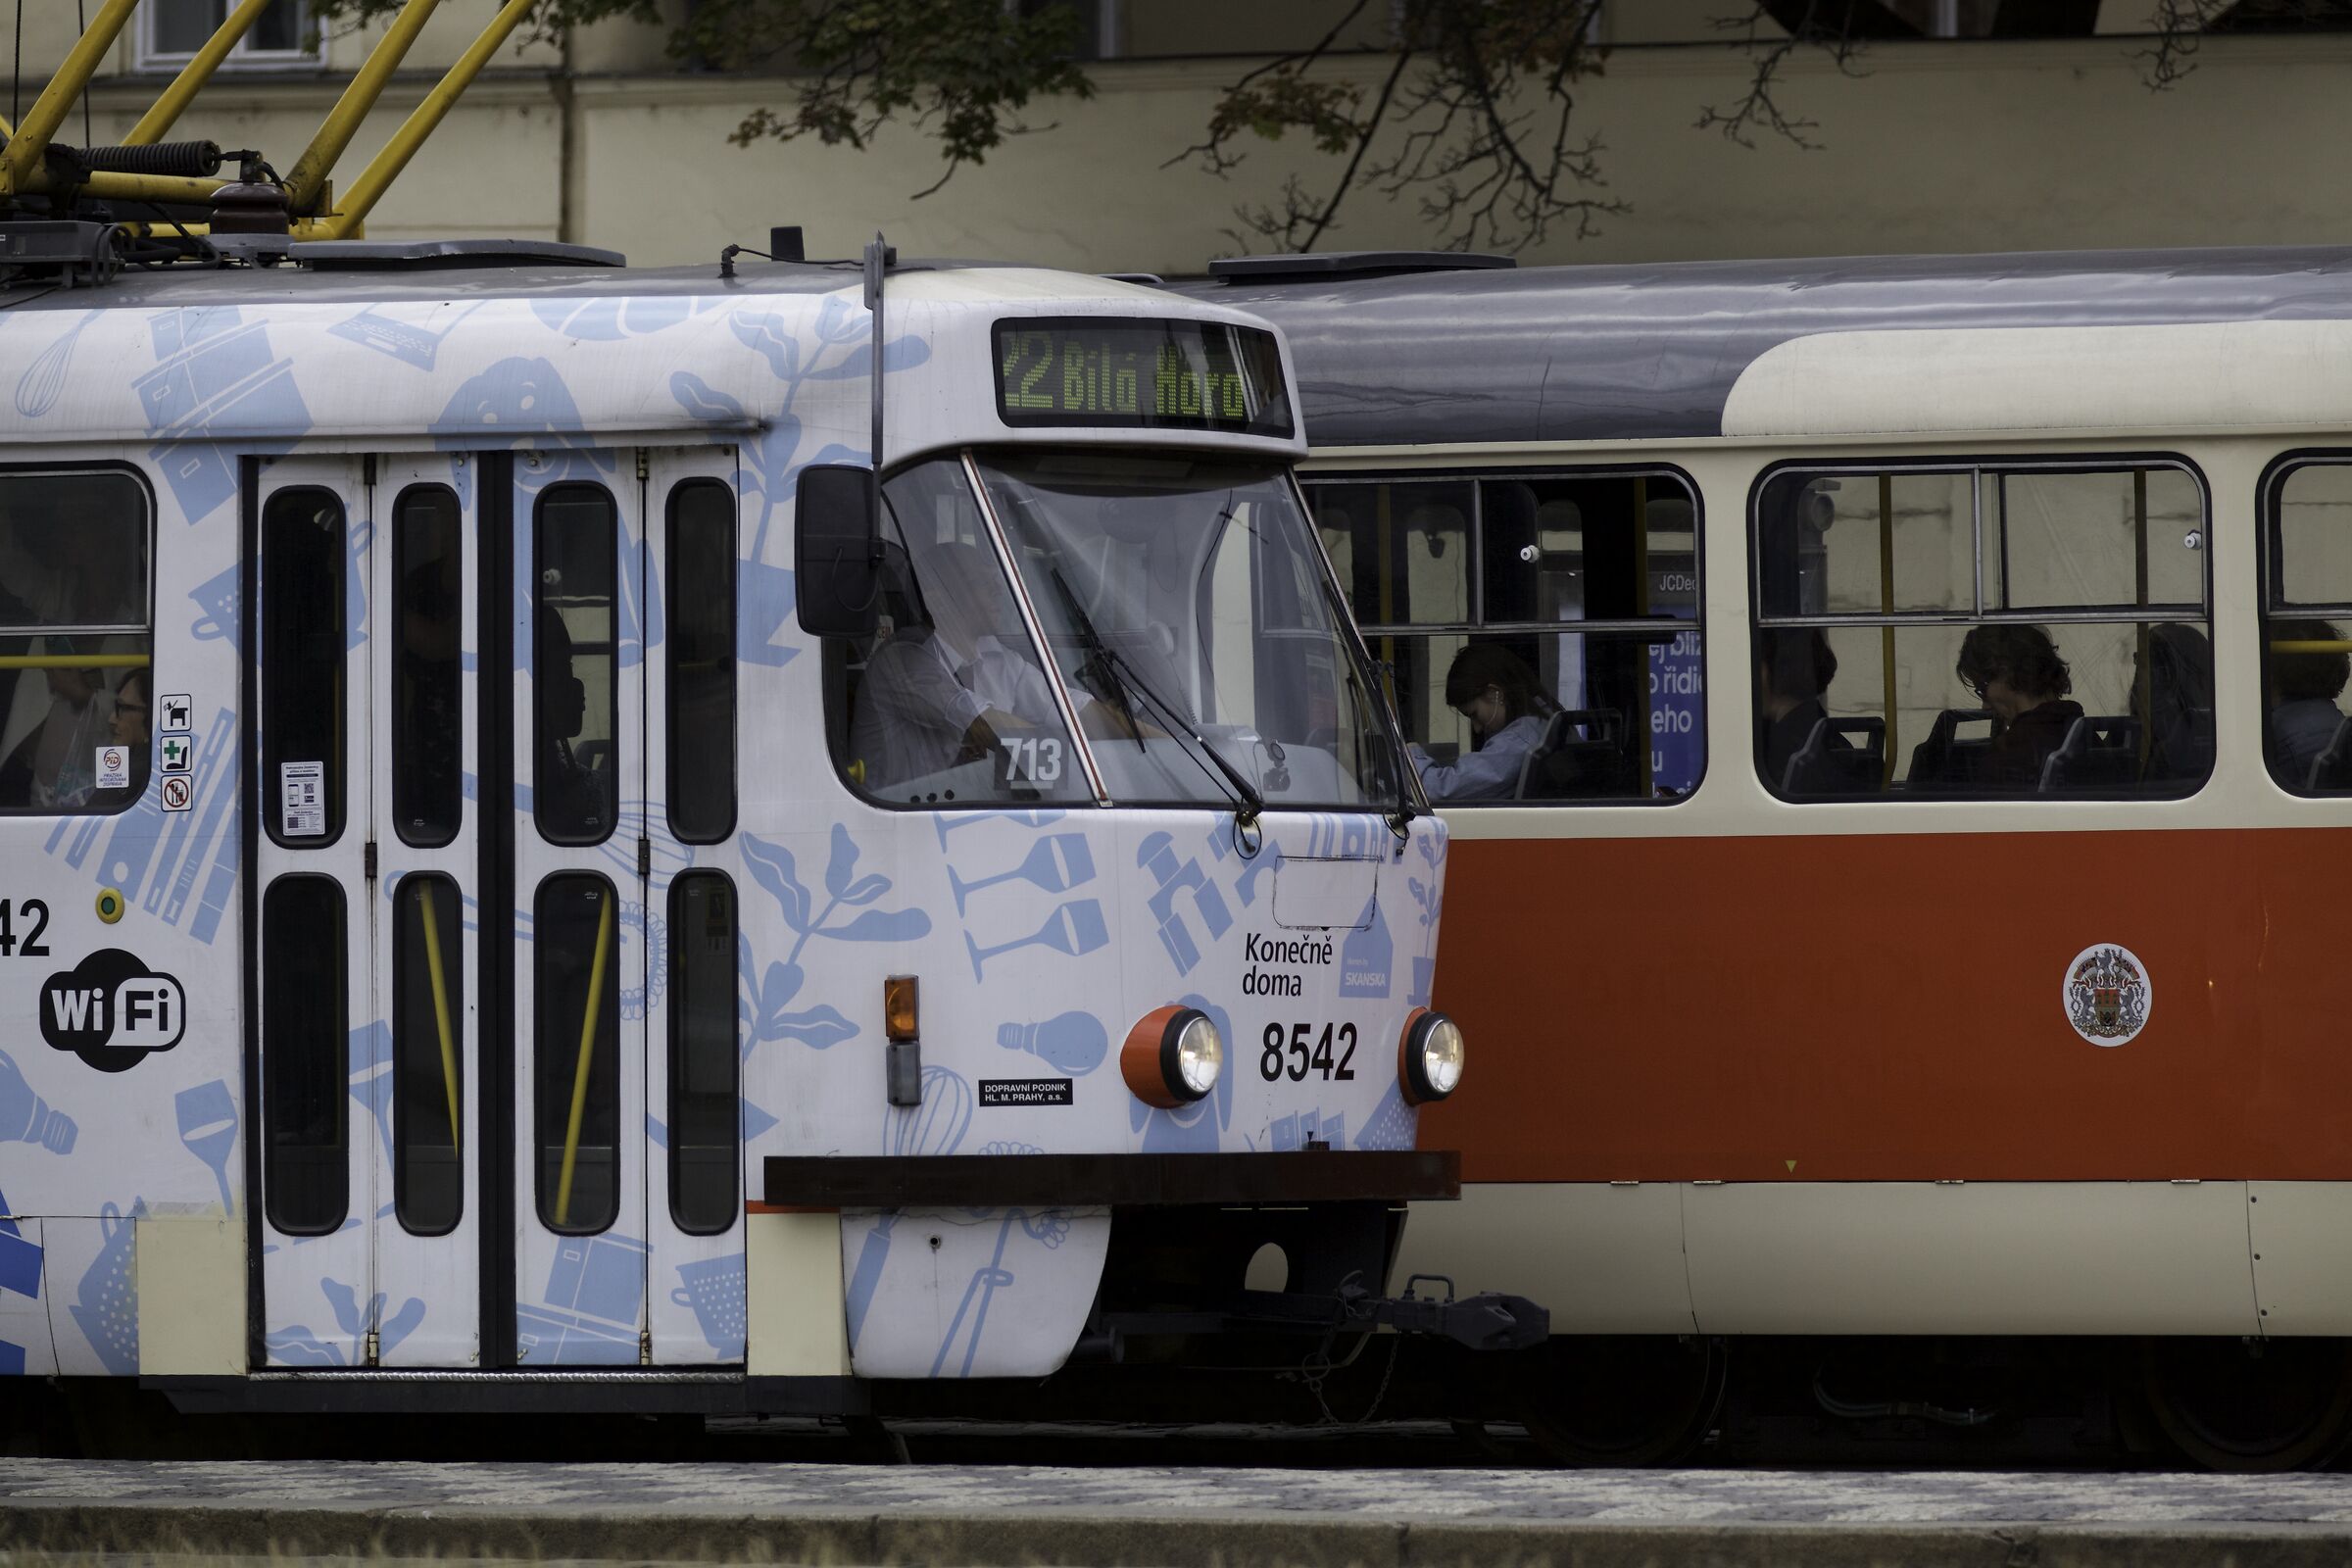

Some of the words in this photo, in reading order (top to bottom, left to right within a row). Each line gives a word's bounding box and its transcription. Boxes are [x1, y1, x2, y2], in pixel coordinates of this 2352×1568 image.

[1000, 738, 1062, 781] 713
[1245, 932, 1333, 965] Konečně
[1243, 964, 1302, 997] doma
[1345, 971, 1387, 987] SKANSKA
[1260, 1022, 1358, 1082] 8542
[985, 1083, 1030, 1093] DOPRAVNÍ
[1032, 1083, 1066, 1092] PODNIK
[1012, 1093, 1046, 1102] PRAHY,
